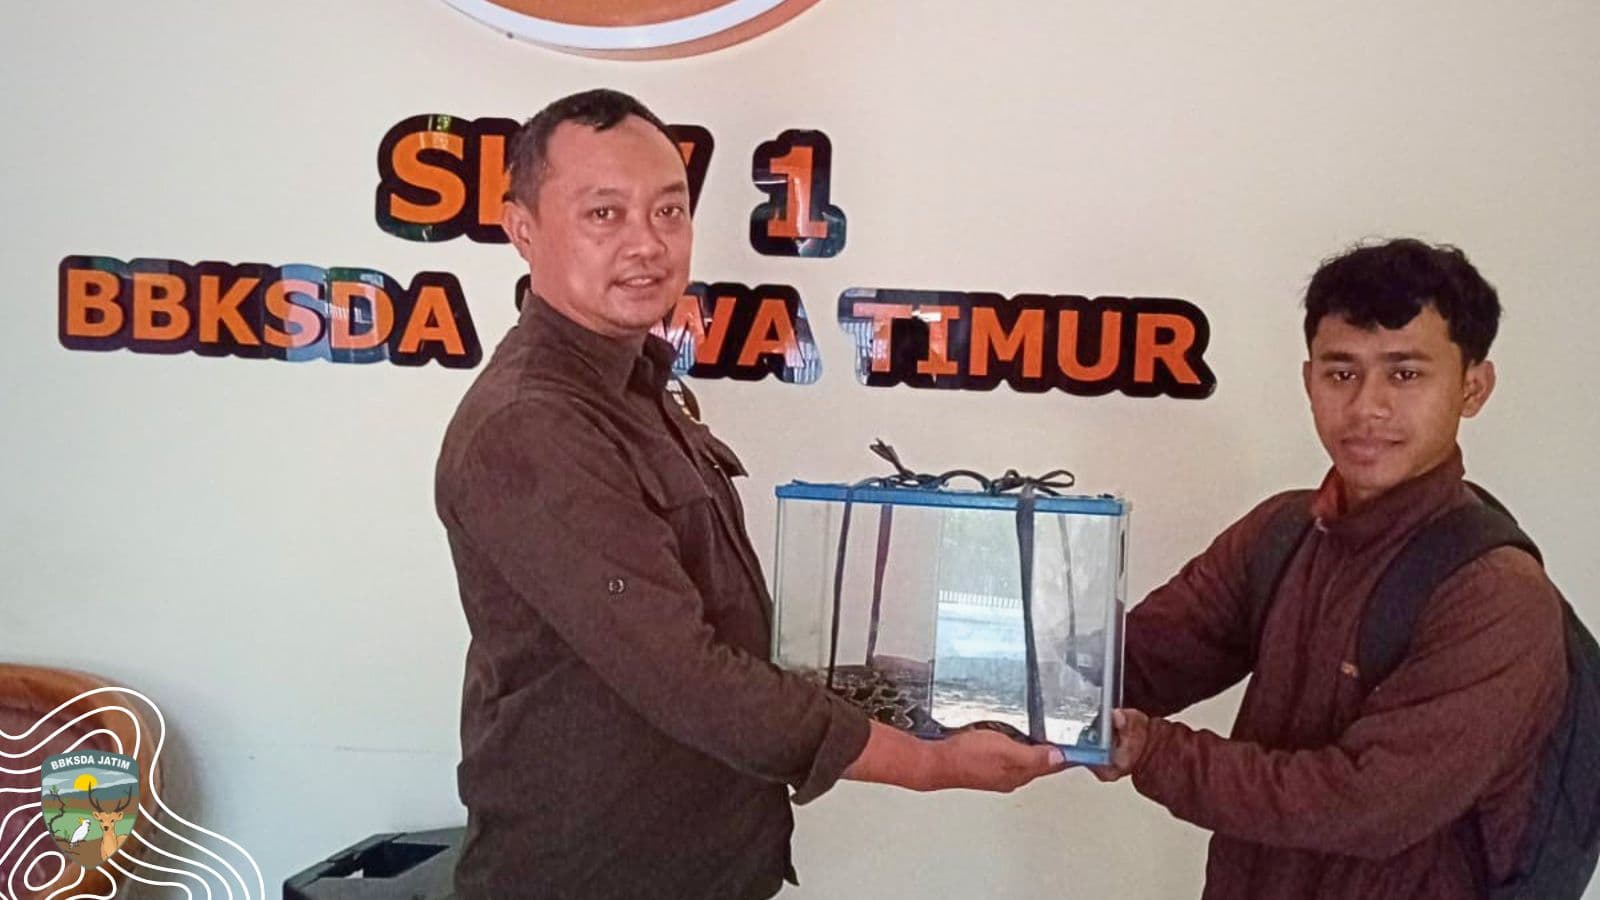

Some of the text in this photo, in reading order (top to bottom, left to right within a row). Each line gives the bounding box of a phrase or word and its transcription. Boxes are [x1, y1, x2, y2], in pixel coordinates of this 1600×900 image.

[767, 144, 829, 239] 1
[66, 268, 1202, 385] BBKSDA WA TIMUR
